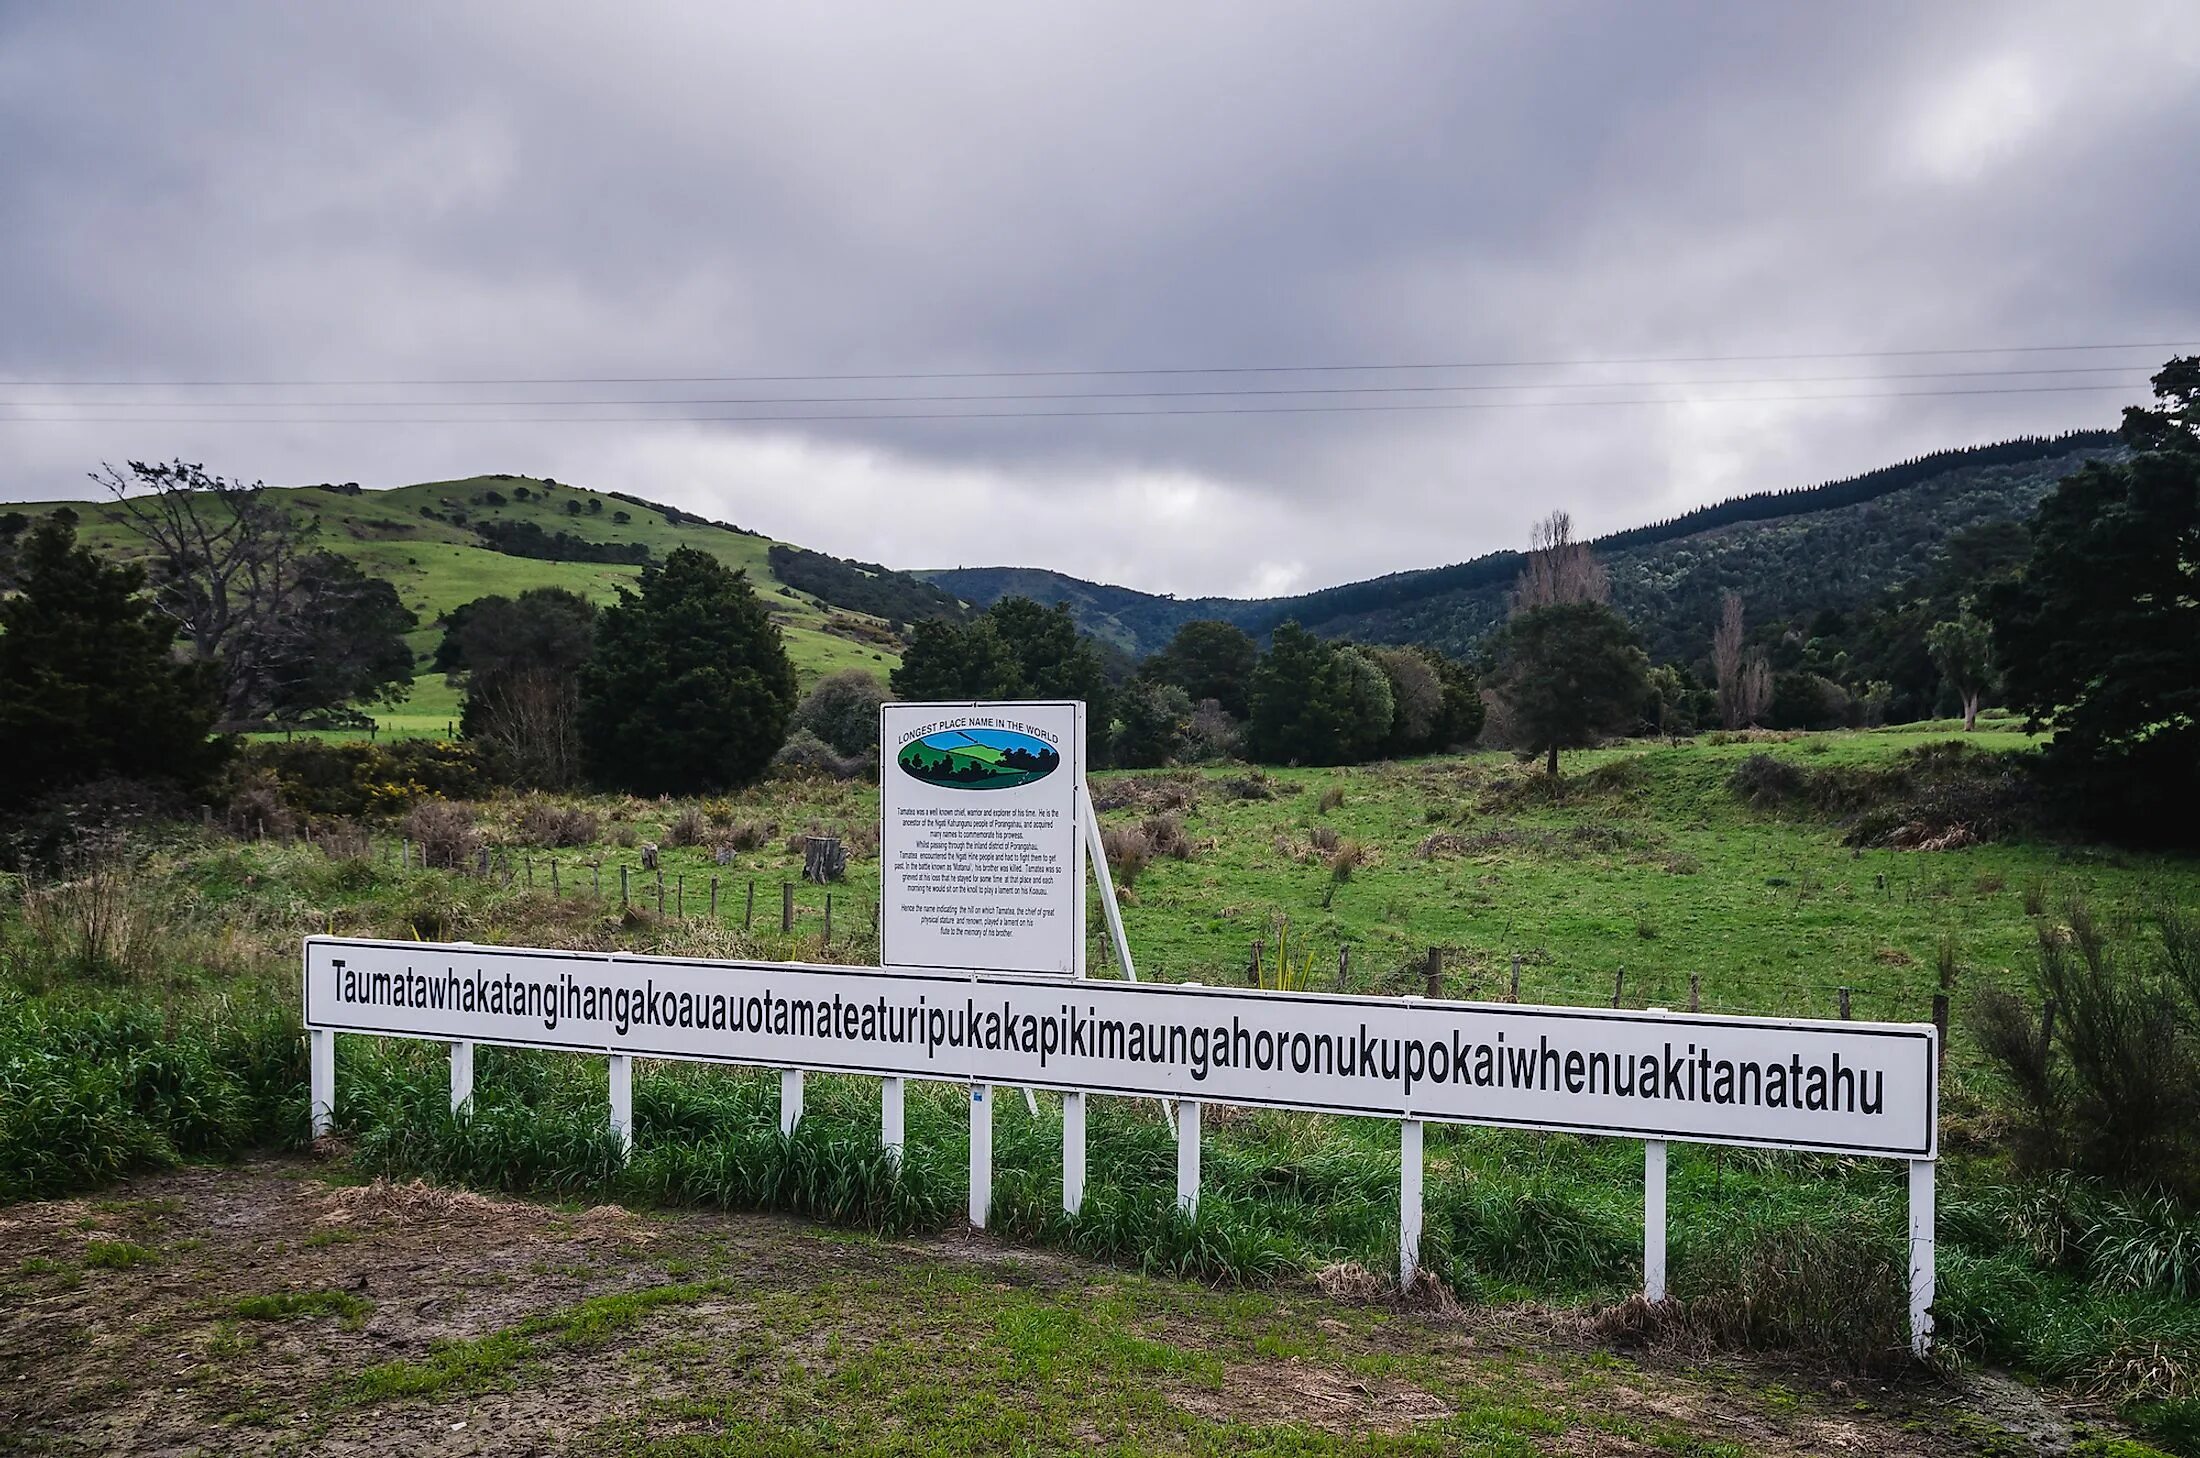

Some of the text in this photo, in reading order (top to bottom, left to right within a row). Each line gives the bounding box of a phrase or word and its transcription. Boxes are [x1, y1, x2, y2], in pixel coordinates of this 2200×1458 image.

[898, 718, 1059, 744] LONGEST PLACE NAME IN THE WORLD
[929, 808, 938, 816] well
[939, 808, 953, 816] known
[967, 808, 983, 816] warrior
[983, 808, 992, 817] and
[993, 808, 1012, 819] explorer
[1017, 809, 1025, 817] his
[1051, 809, 1059, 817] the
[902, 818, 921, 826] ancestor
[973, 819, 988, 829] people
[1023, 820, 1033, 828] and
[930, 831, 942, 840] many
[963, 830, 995, 838] commemorate
[930, 840, 948, 851] passing
[948, 840, 965, 851] through
[974, 841, 988, 849] inland
[988, 841, 1004, 849] district
[979, 852, 994, 862] people
[995, 852, 1004, 860] and
[1004, 852, 1014, 861] had
[1020, 853, 1030, 863] fight
[1031, 853, 1042, 861] them
[918, 862, 931, 871] battle
[932, 862, 946, 871] known
[983, 863, 998, 872] brother
[941, 873, 950, 882] that
[957, 874, 972, 884] stayed
[1009, 875, 1019, 883] that
[1019, 875, 1032, 885] place
[1032, 875, 1042, 883] and
[1042, 875, 1054, 884] each
[907, 883, 925, 893] morning
[933, 884, 945, 892] would
[967, 885, 978, 893] knoll
[984, 885, 994, 896] play
[998, 886, 1014, 894] lament
[901, 903, 915, 912] Hence
[915, 904, 923, 912] the
[936, 905, 957, 915] indicating
[981, 906, 995, 914] which
[1016, 907, 1024, 915] the
[1025, 907, 1036, 915] chief
[1042, 907, 1055, 918] great
[921, 915, 938, 925] physical
[956, 916, 965, 924] and
[984, 917, 998, 927] played
[1003, 917, 1019, 926] lament
[940, 927, 950, 935] flute
[955, 927, 963, 935] the
[964, 929, 982, 938] memory
[332, 959, 1883, 1115] Taumatawhakatangihangakoauauotamateaturipukakapikimaungahoronukupokaiwhenuakitanatahu
